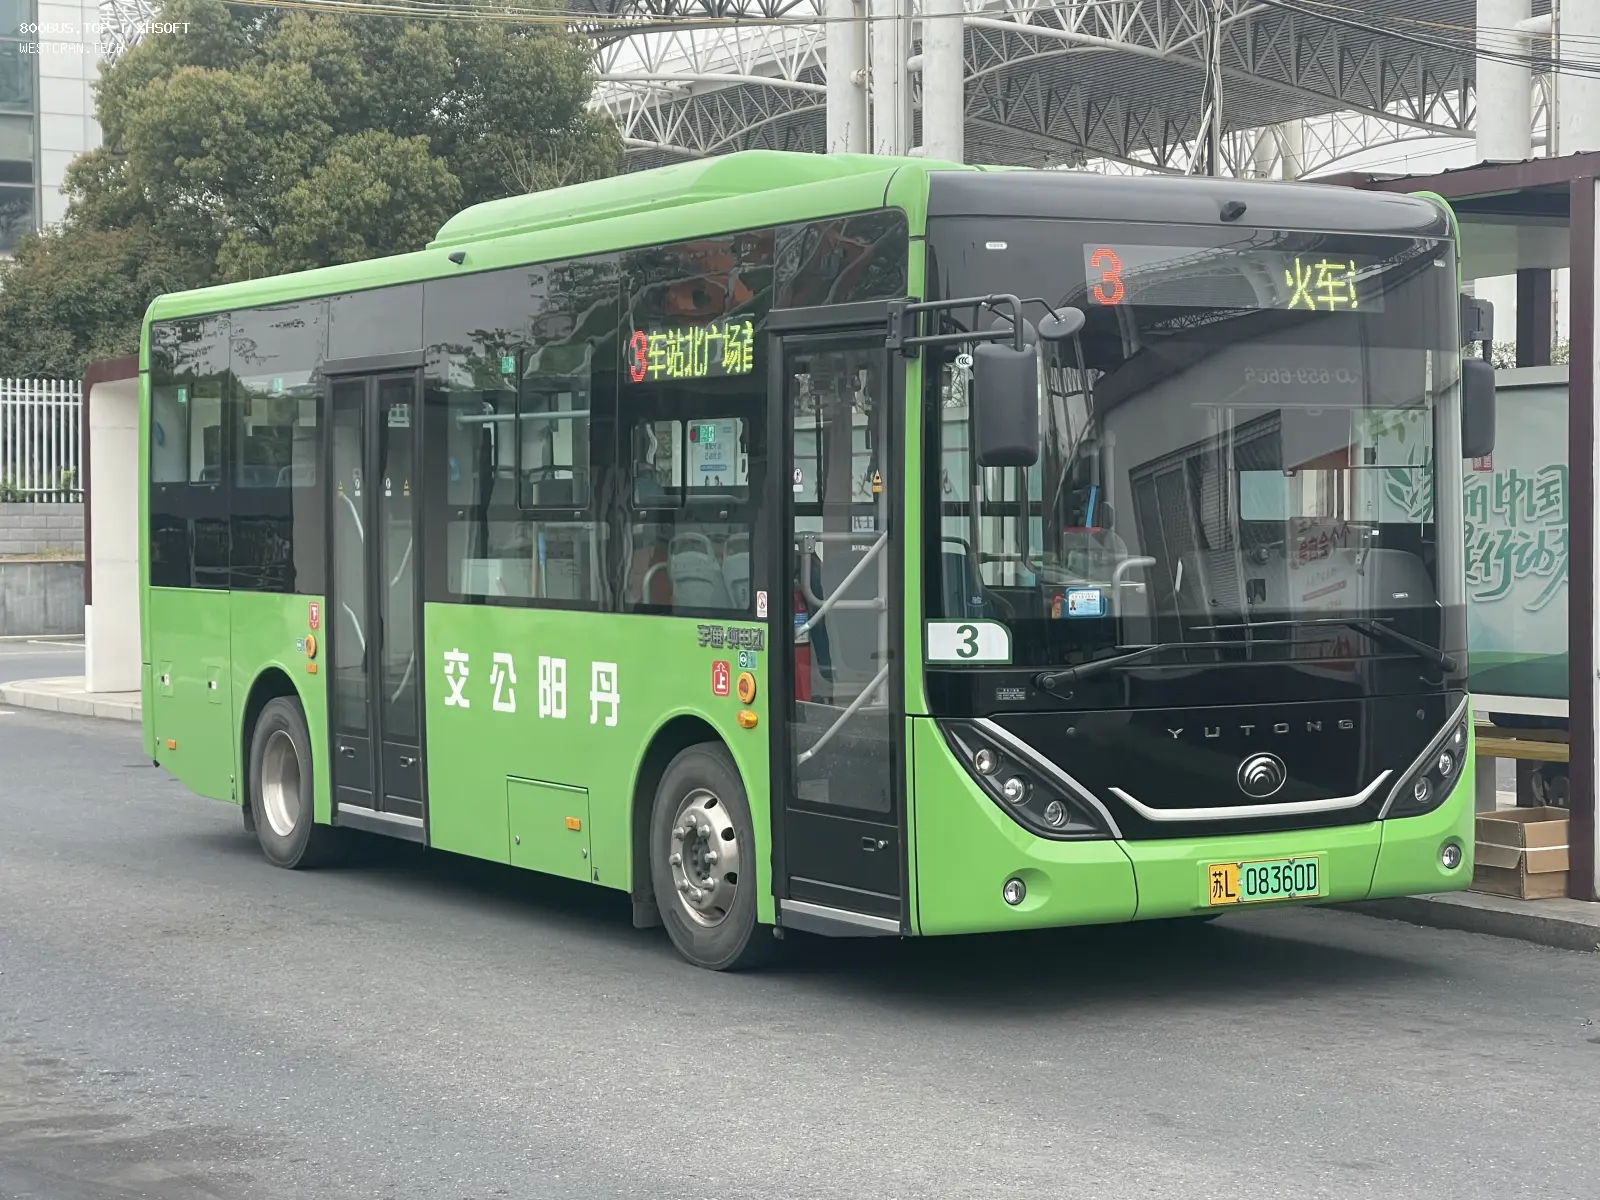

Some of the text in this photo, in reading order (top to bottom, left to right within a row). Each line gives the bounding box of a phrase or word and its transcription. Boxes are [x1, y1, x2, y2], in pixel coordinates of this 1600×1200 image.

[1091, 248, 1125, 305] 3
[956, 624, 979, 659] 3
[717, 672, 726, 690] 上
[1167, 719, 1354, 739] YUTONG
